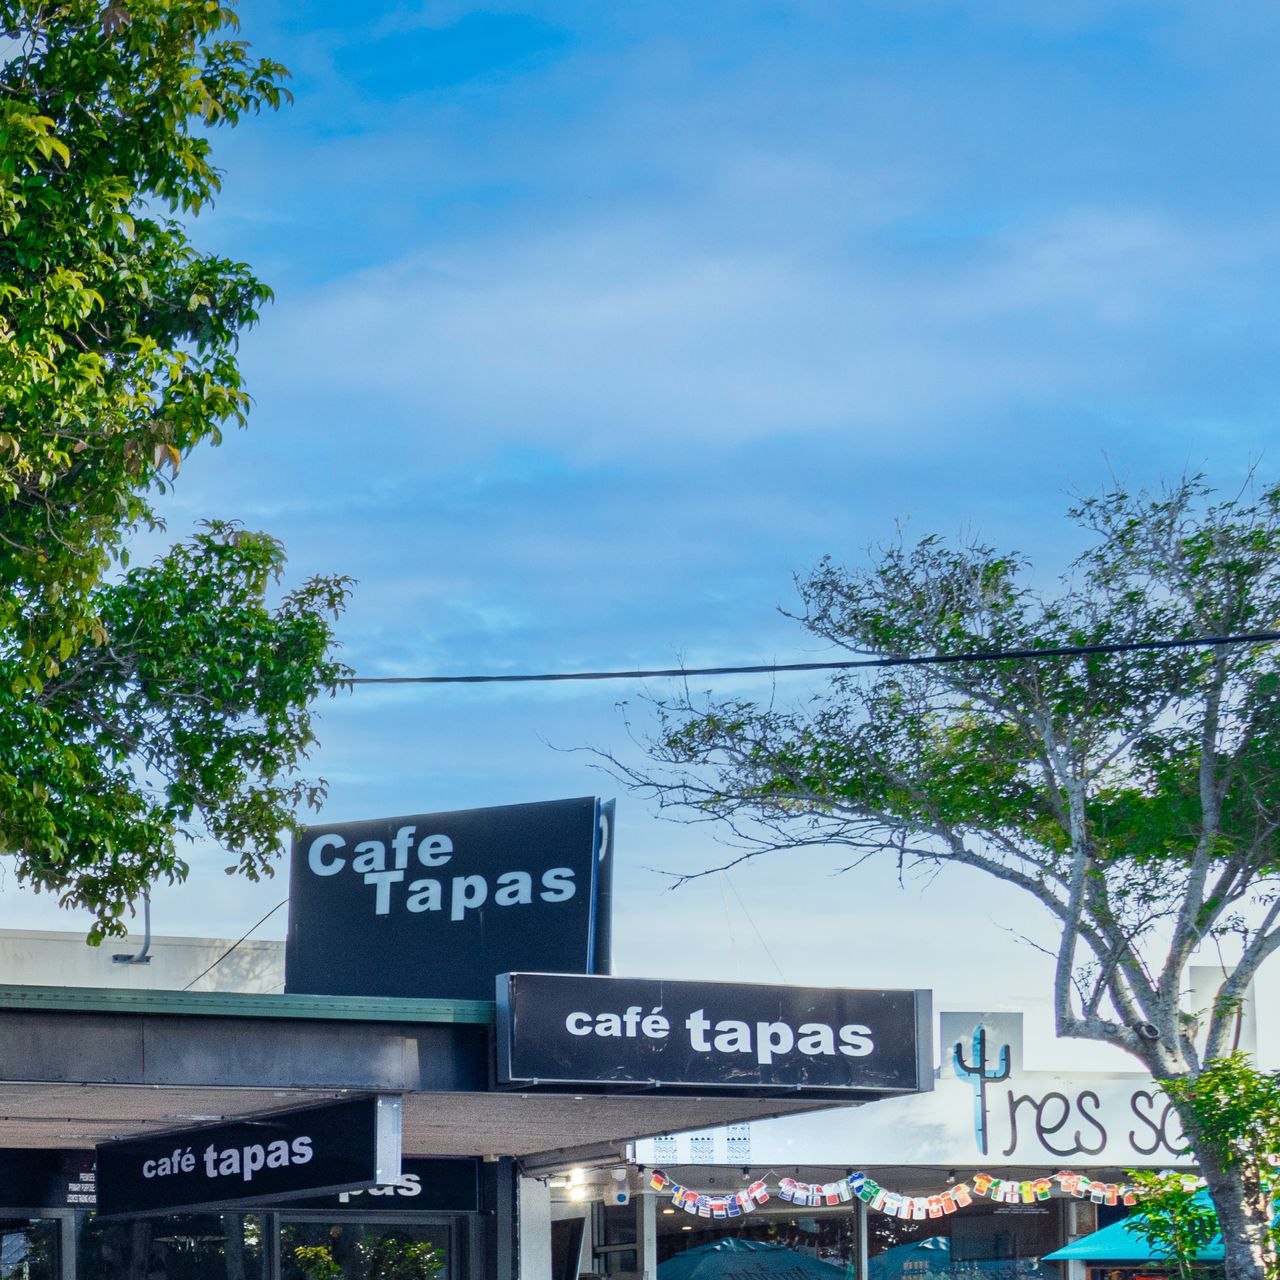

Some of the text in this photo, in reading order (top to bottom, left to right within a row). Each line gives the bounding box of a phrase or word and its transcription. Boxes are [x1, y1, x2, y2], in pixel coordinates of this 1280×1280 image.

[307, 825, 454, 877] Cafe
[363, 865, 577, 921] Tapas
[565, 1006, 875, 1065] café tapas
[142, 1135, 314, 1182] café tapas
